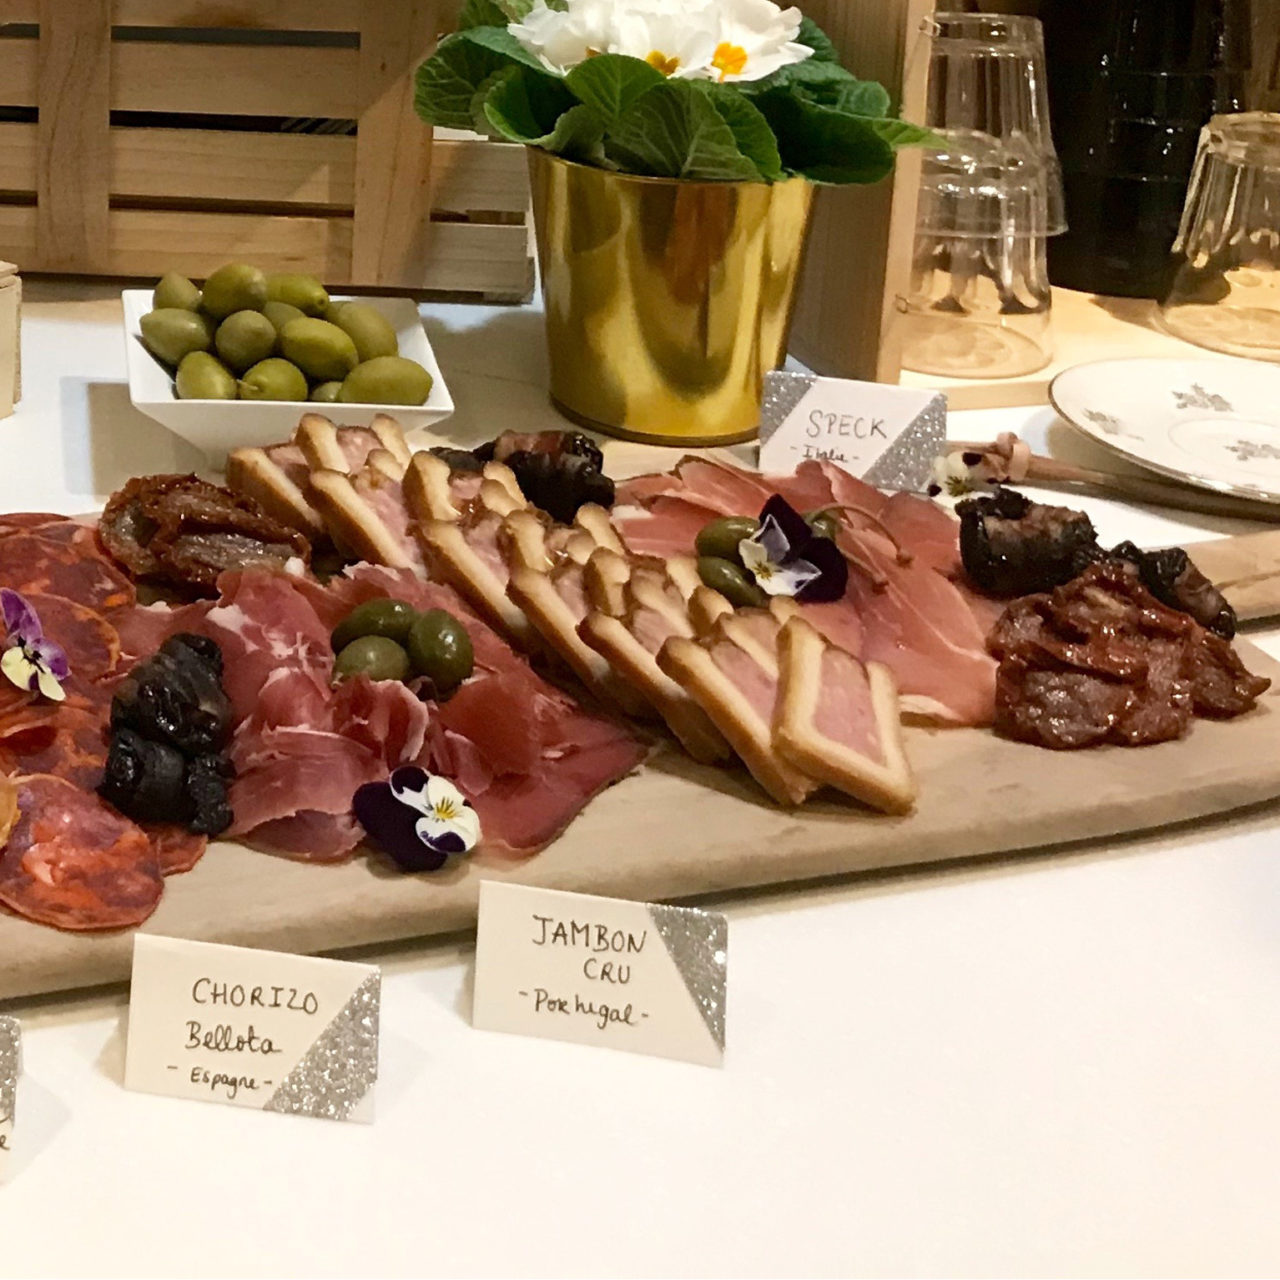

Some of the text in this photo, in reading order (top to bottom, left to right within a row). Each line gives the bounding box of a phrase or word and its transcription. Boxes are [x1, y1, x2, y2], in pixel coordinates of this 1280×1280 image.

[806, 410, 887, 439] SPECK
[532, 914, 647, 953] JAMBON
[583, 958, 630, 984] CRU
[192, 977, 318, 1014] CHORIZO
[185, 1021, 282, 1054] Bellota
